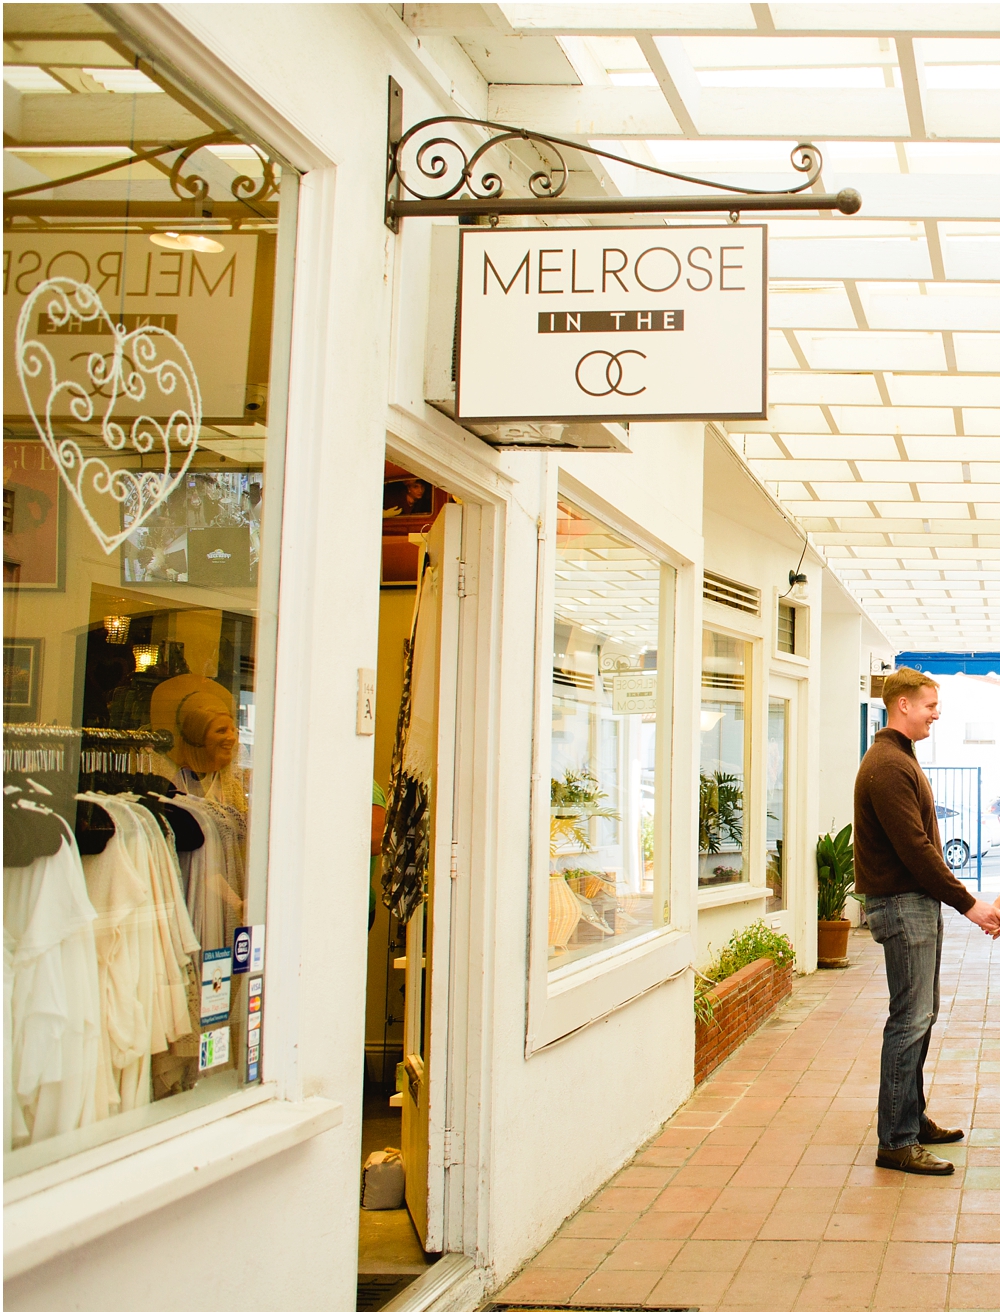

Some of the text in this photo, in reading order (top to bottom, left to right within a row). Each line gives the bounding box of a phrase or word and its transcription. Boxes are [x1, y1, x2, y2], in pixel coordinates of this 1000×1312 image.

[482, 246, 746, 295] MELROSE
[550, 311, 676, 332] IN THE
[575, 349, 647, 397] OC
